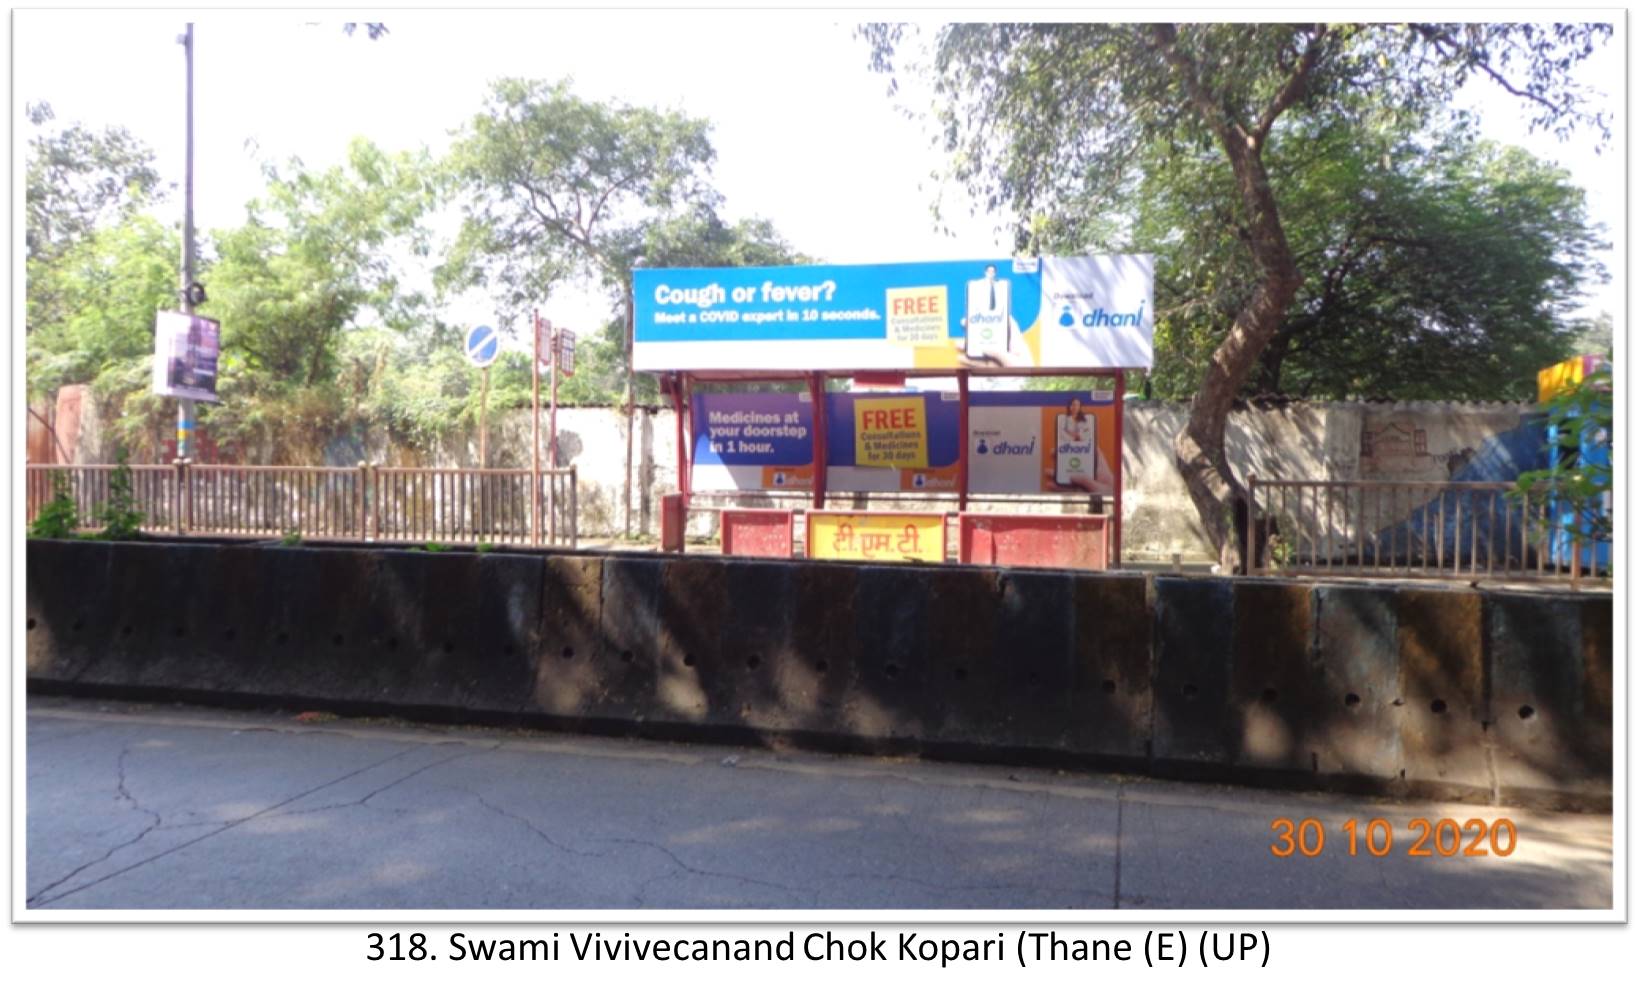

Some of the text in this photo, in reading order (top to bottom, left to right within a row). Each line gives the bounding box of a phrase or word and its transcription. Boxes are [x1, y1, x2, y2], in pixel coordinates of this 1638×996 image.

[654, 280, 837, 307] Cough or fever?
[893, 296, 940, 316] FREE
[1082, 299, 1146, 328] dhani
[654, 307, 881, 325] Meet a COVID expert in 10 seconds.
[969, 311, 1004, 325] dhani
[708, 410, 800, 425] Medicines at
[863, 408, 917, 430] FREE
[708, 423, 808, 439] your doorstep
[709, 440, 775, 454] in 1 hour.
[992, 436, 1037, 456] dhani
[1058, 439, 1092, 455] dhani
